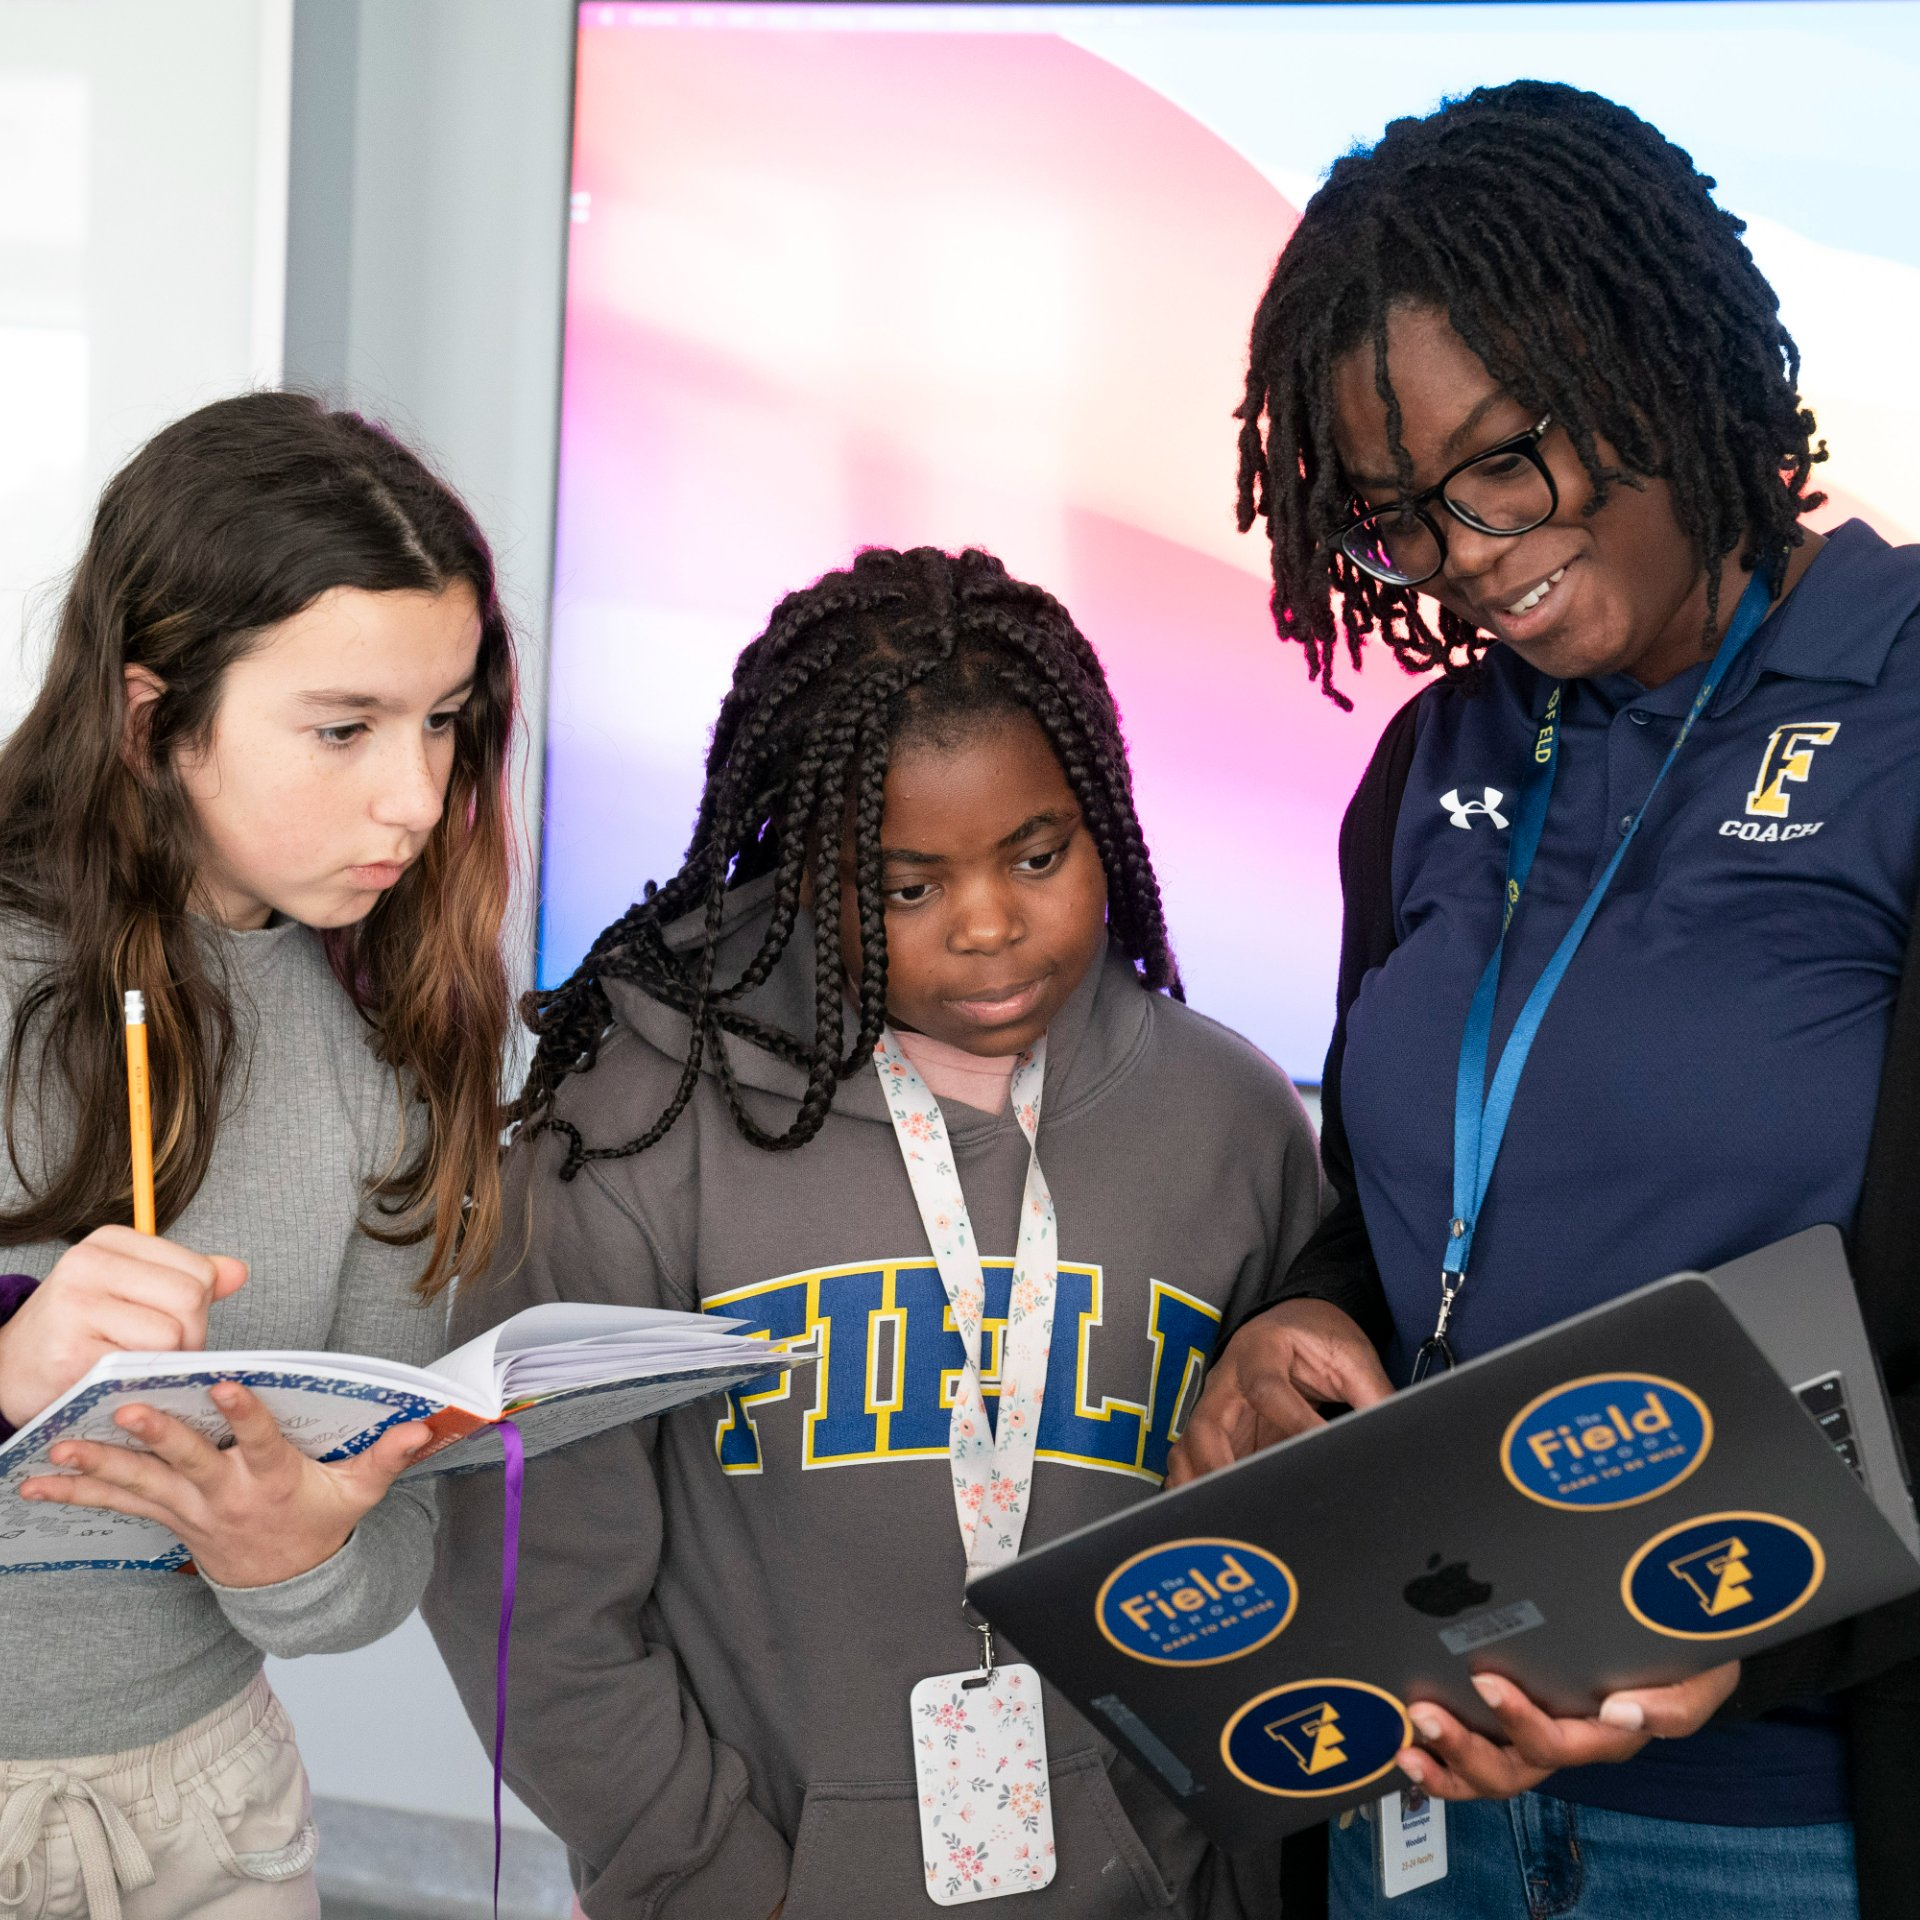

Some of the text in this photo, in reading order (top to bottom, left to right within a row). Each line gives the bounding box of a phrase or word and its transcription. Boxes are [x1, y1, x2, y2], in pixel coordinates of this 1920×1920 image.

[1535, 709, 1556, 763] FELD
[1746, 721, 1841, 818] F
[1718, 820, 1824, 842] COACH
[1526, 1391, 1672, 1469] Field
[1119, 1553, 1255, 1632] Field
